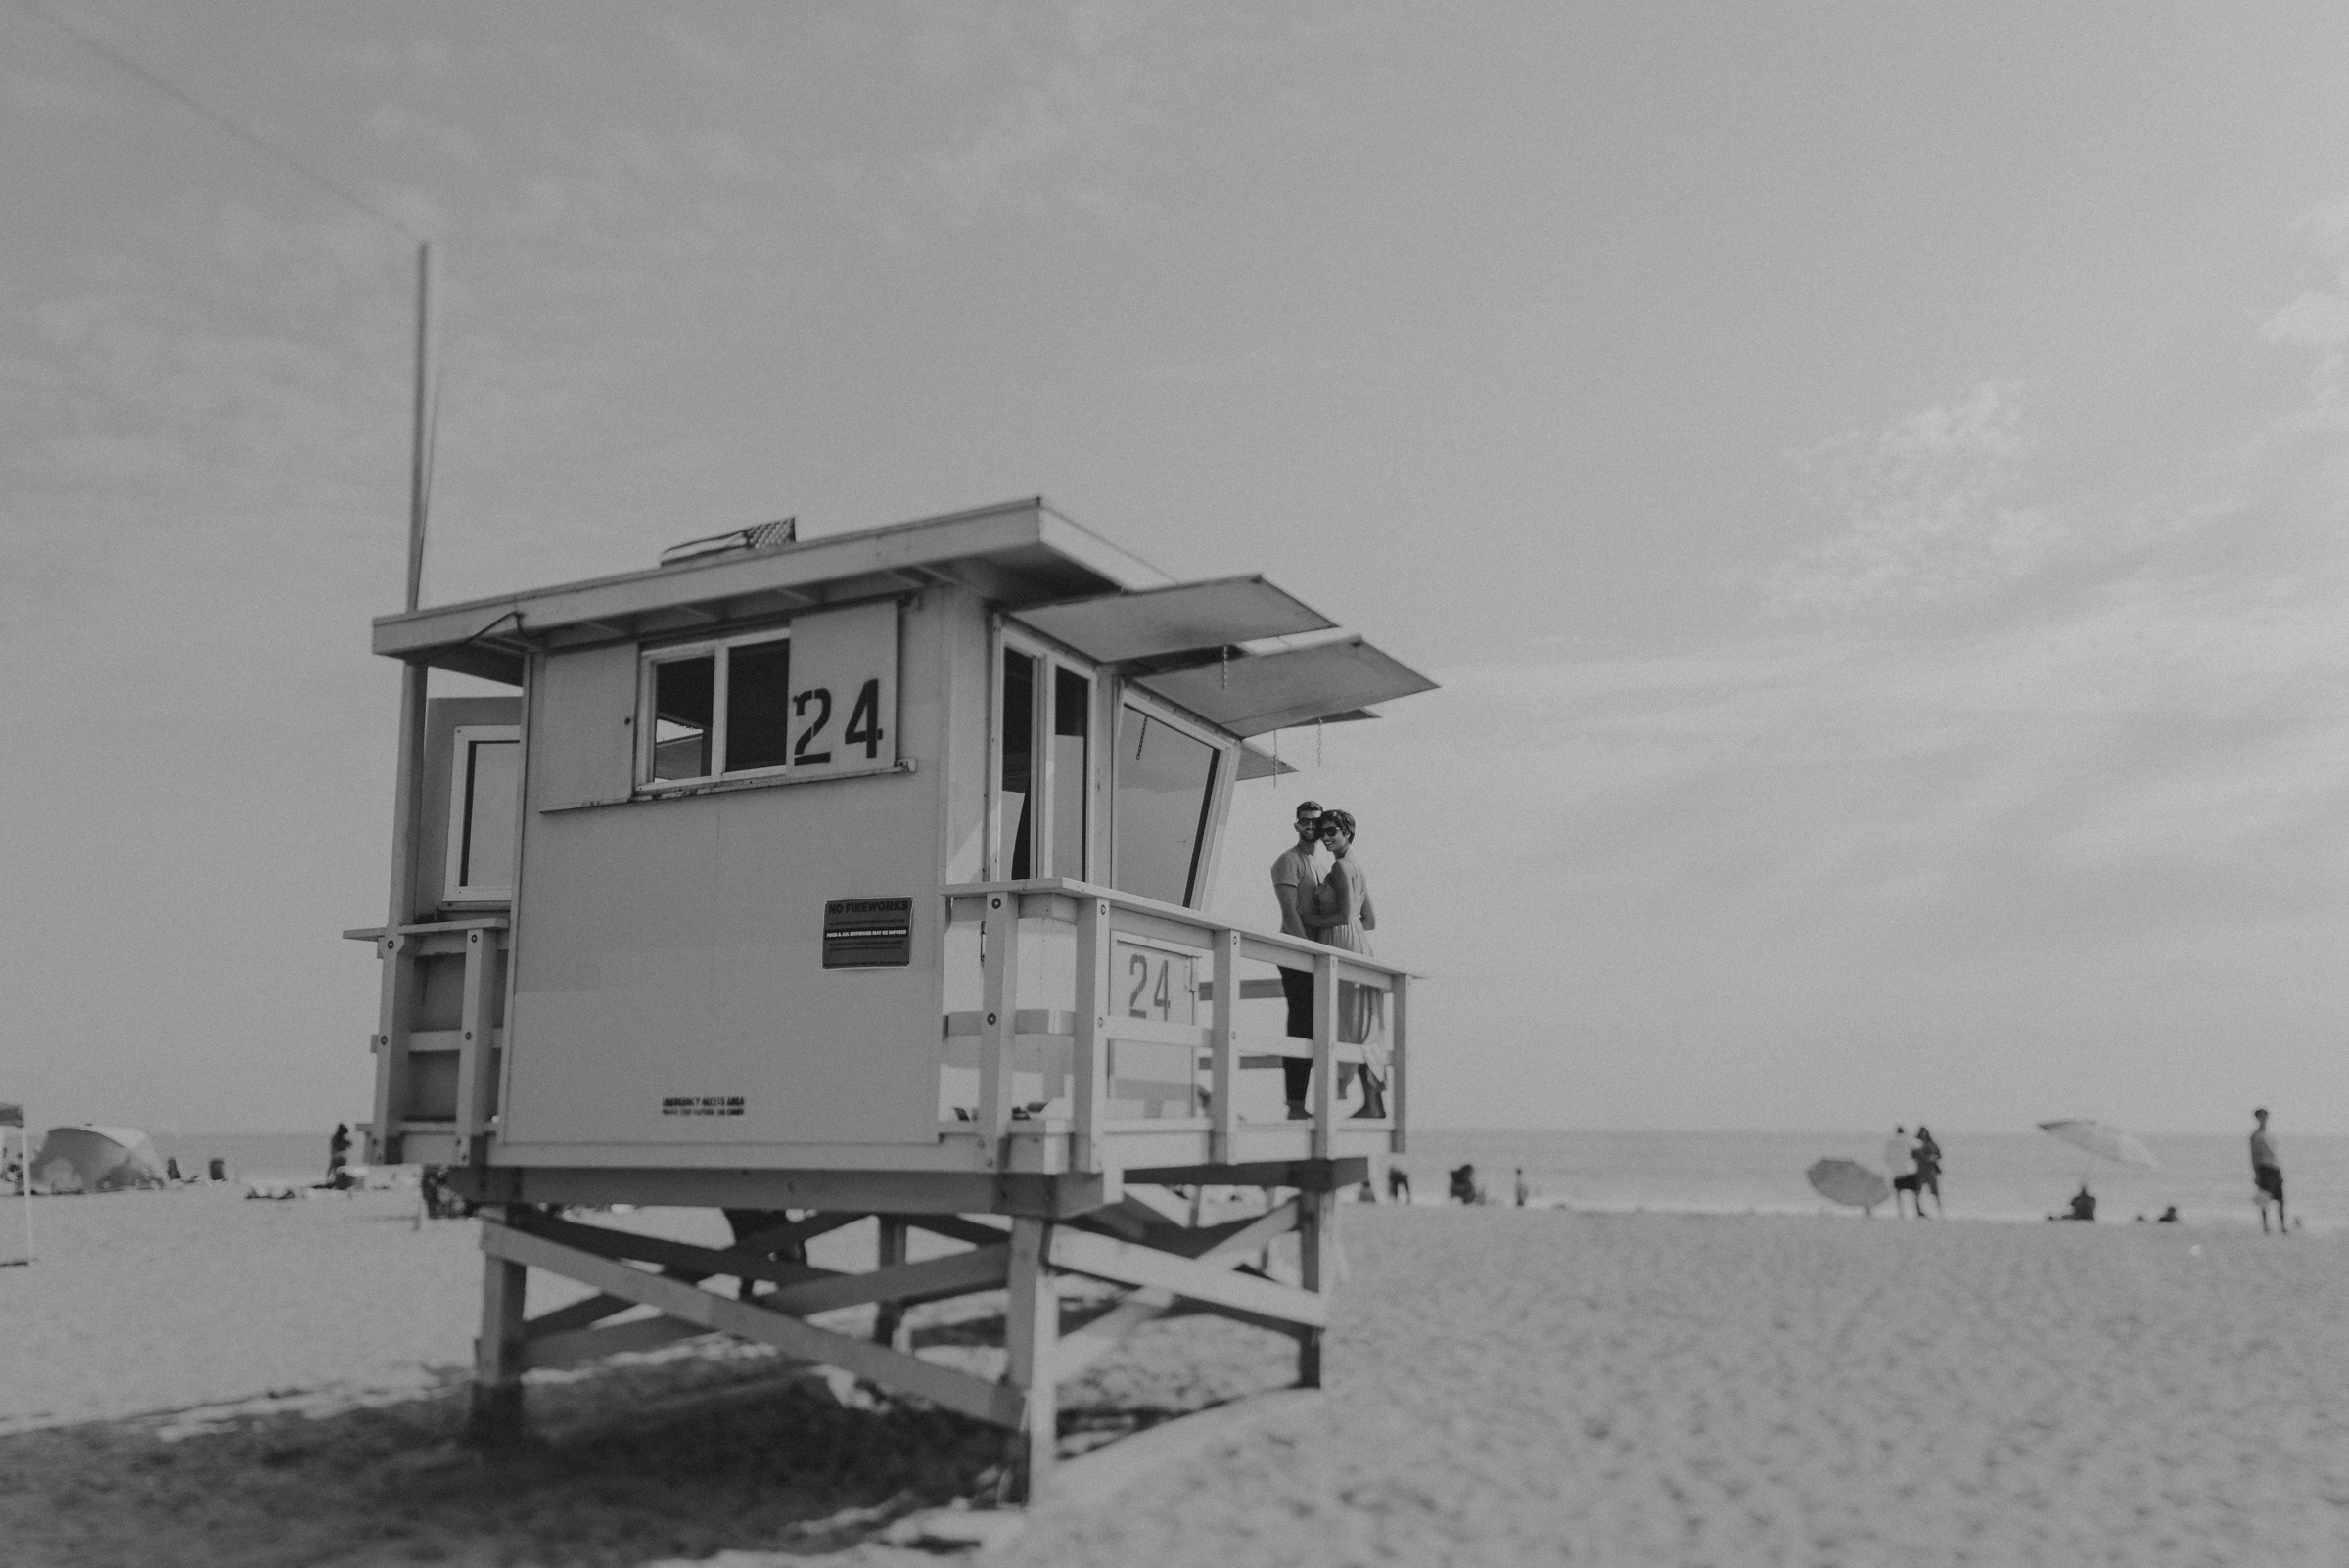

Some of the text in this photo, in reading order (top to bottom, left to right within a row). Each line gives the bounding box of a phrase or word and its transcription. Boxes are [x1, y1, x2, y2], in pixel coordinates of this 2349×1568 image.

[793, 678, 883, 766] 24
[828, 900, 908, 914] NO FIREWORKS
[1128, 953, 1171, 1021] 24
[662, 1096, 745, 1107] EMERGENCY ACCESS AREA
